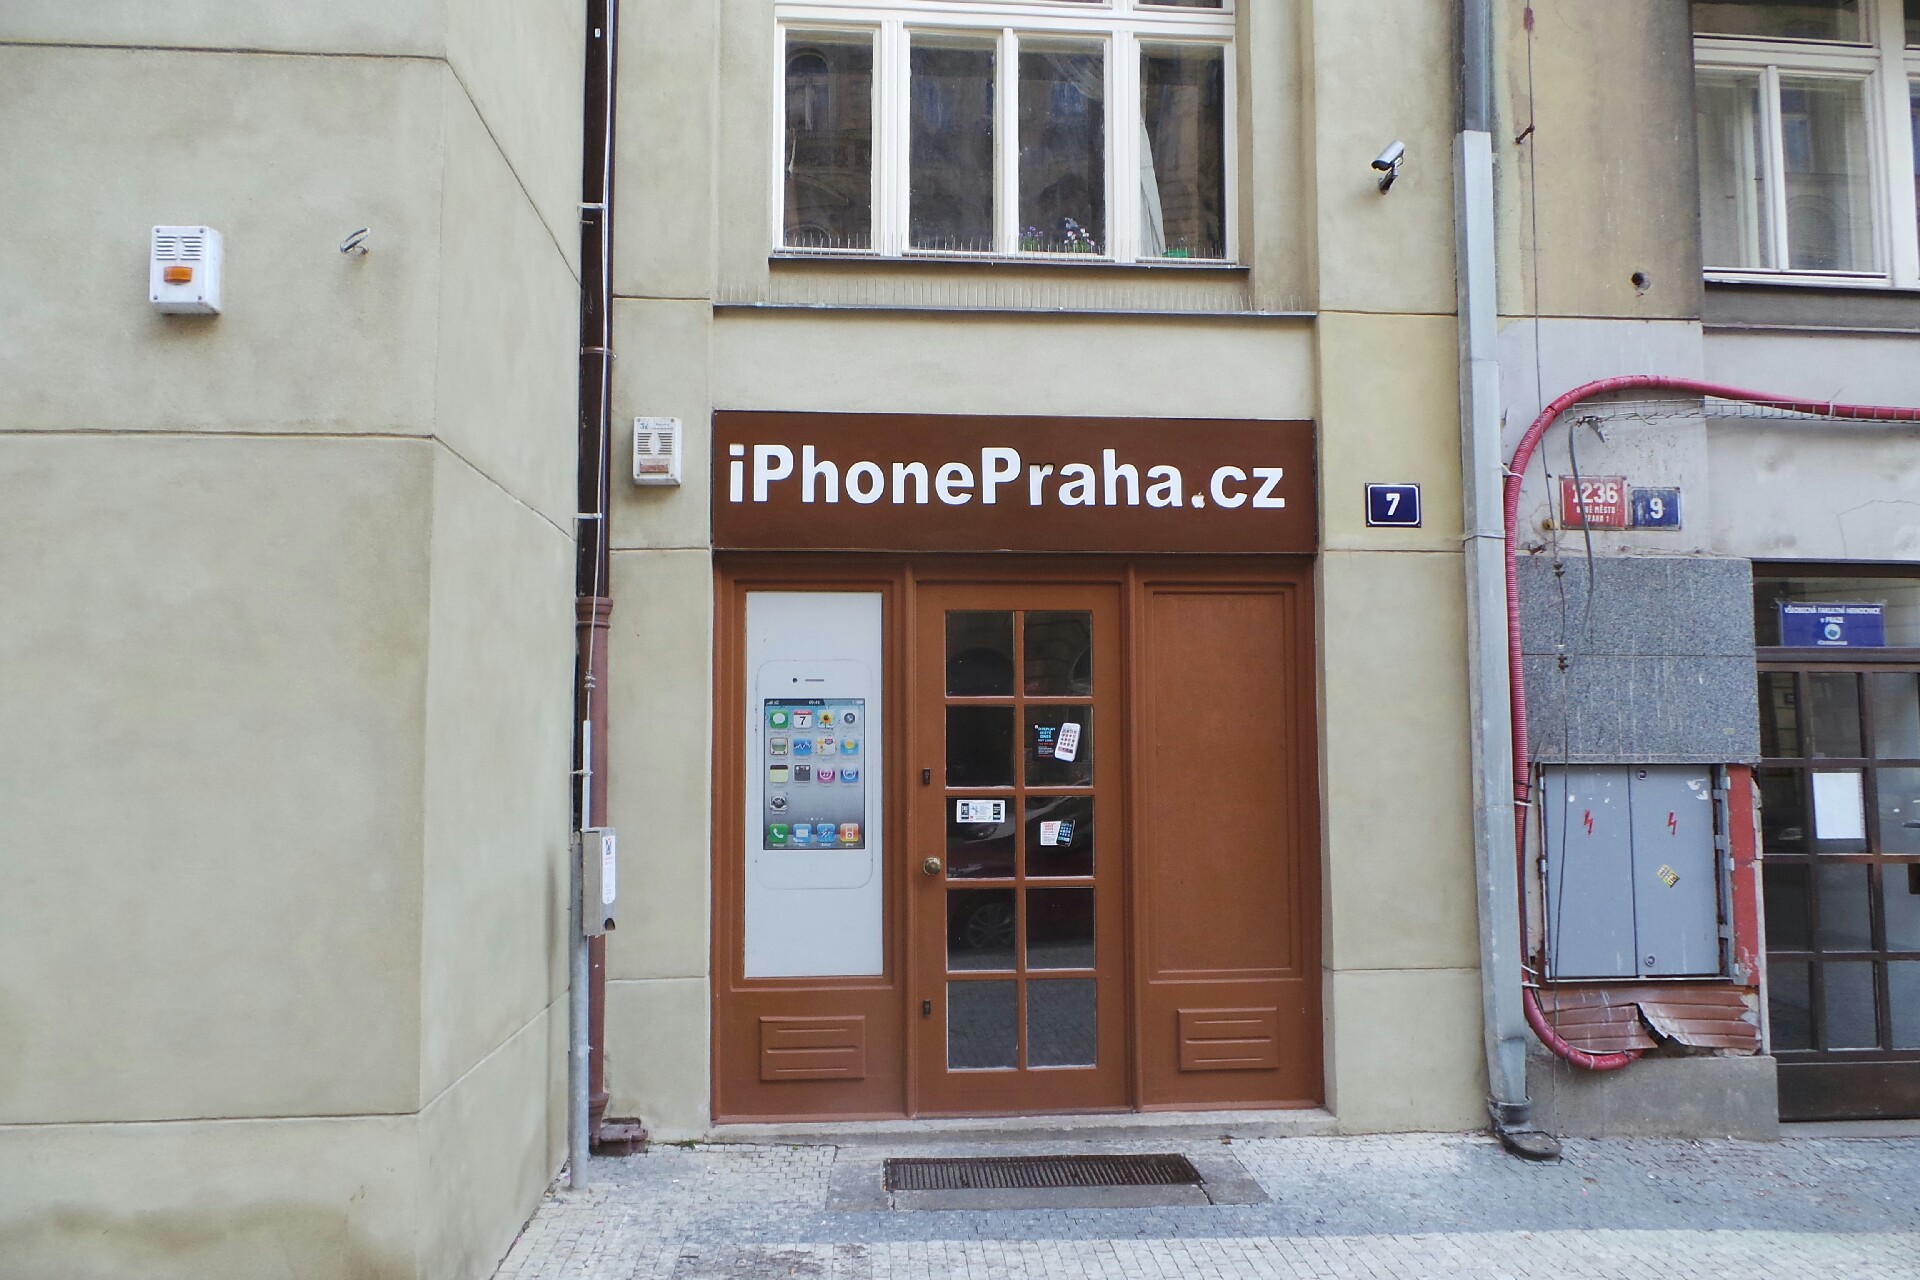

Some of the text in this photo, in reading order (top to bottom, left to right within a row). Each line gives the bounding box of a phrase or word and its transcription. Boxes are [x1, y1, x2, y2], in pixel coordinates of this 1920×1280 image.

[729, 443, 1286, 508] iPhonePraha.cz
[1572, 482, 1618, 503] 1236
[1386, 493, 1400, 516] 7
[1576, 504, 1593, 514] NVÉ
[1650, 498, 1663, 518] 9
[799, 716, 807, 726] 7
